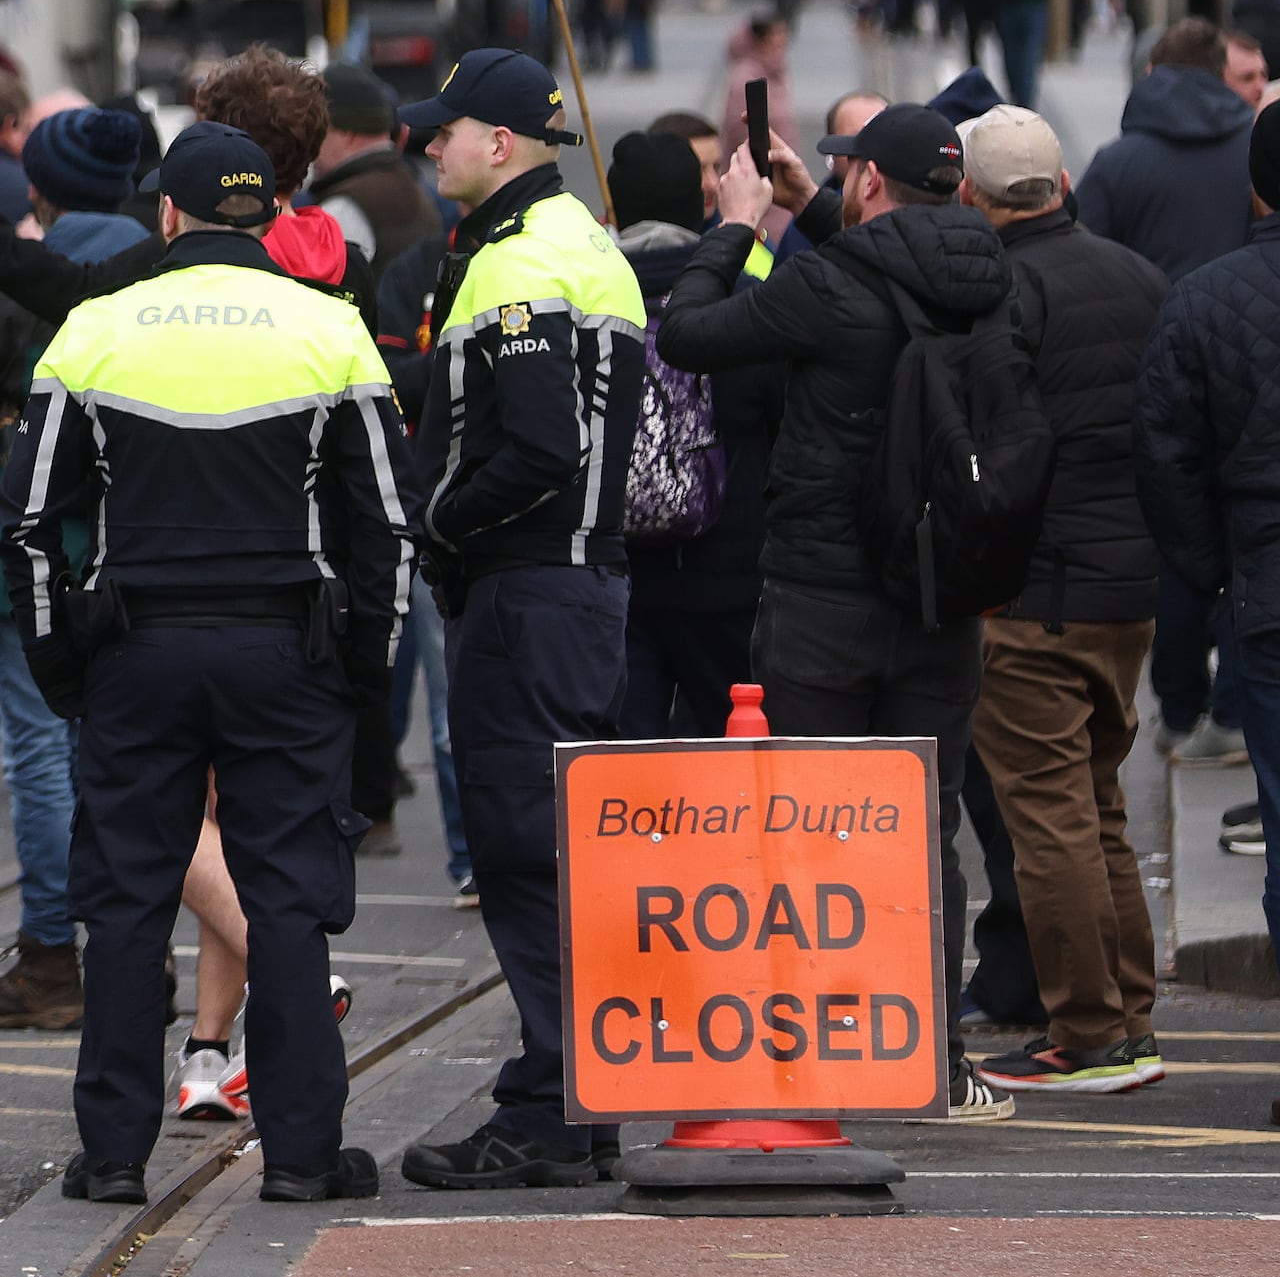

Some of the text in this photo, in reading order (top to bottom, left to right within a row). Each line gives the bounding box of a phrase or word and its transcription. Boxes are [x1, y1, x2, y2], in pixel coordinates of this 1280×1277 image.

[221, 173, 263, 188] GARDA
[136, 305, 276, 328] GARDA
[498, 337, 551, 359] ARDA
[597, 794, 900, 838] Bothar Dunta
[636, 883, 866, 954] ROAD
[592, 993, 921, 1066] CLOSED
